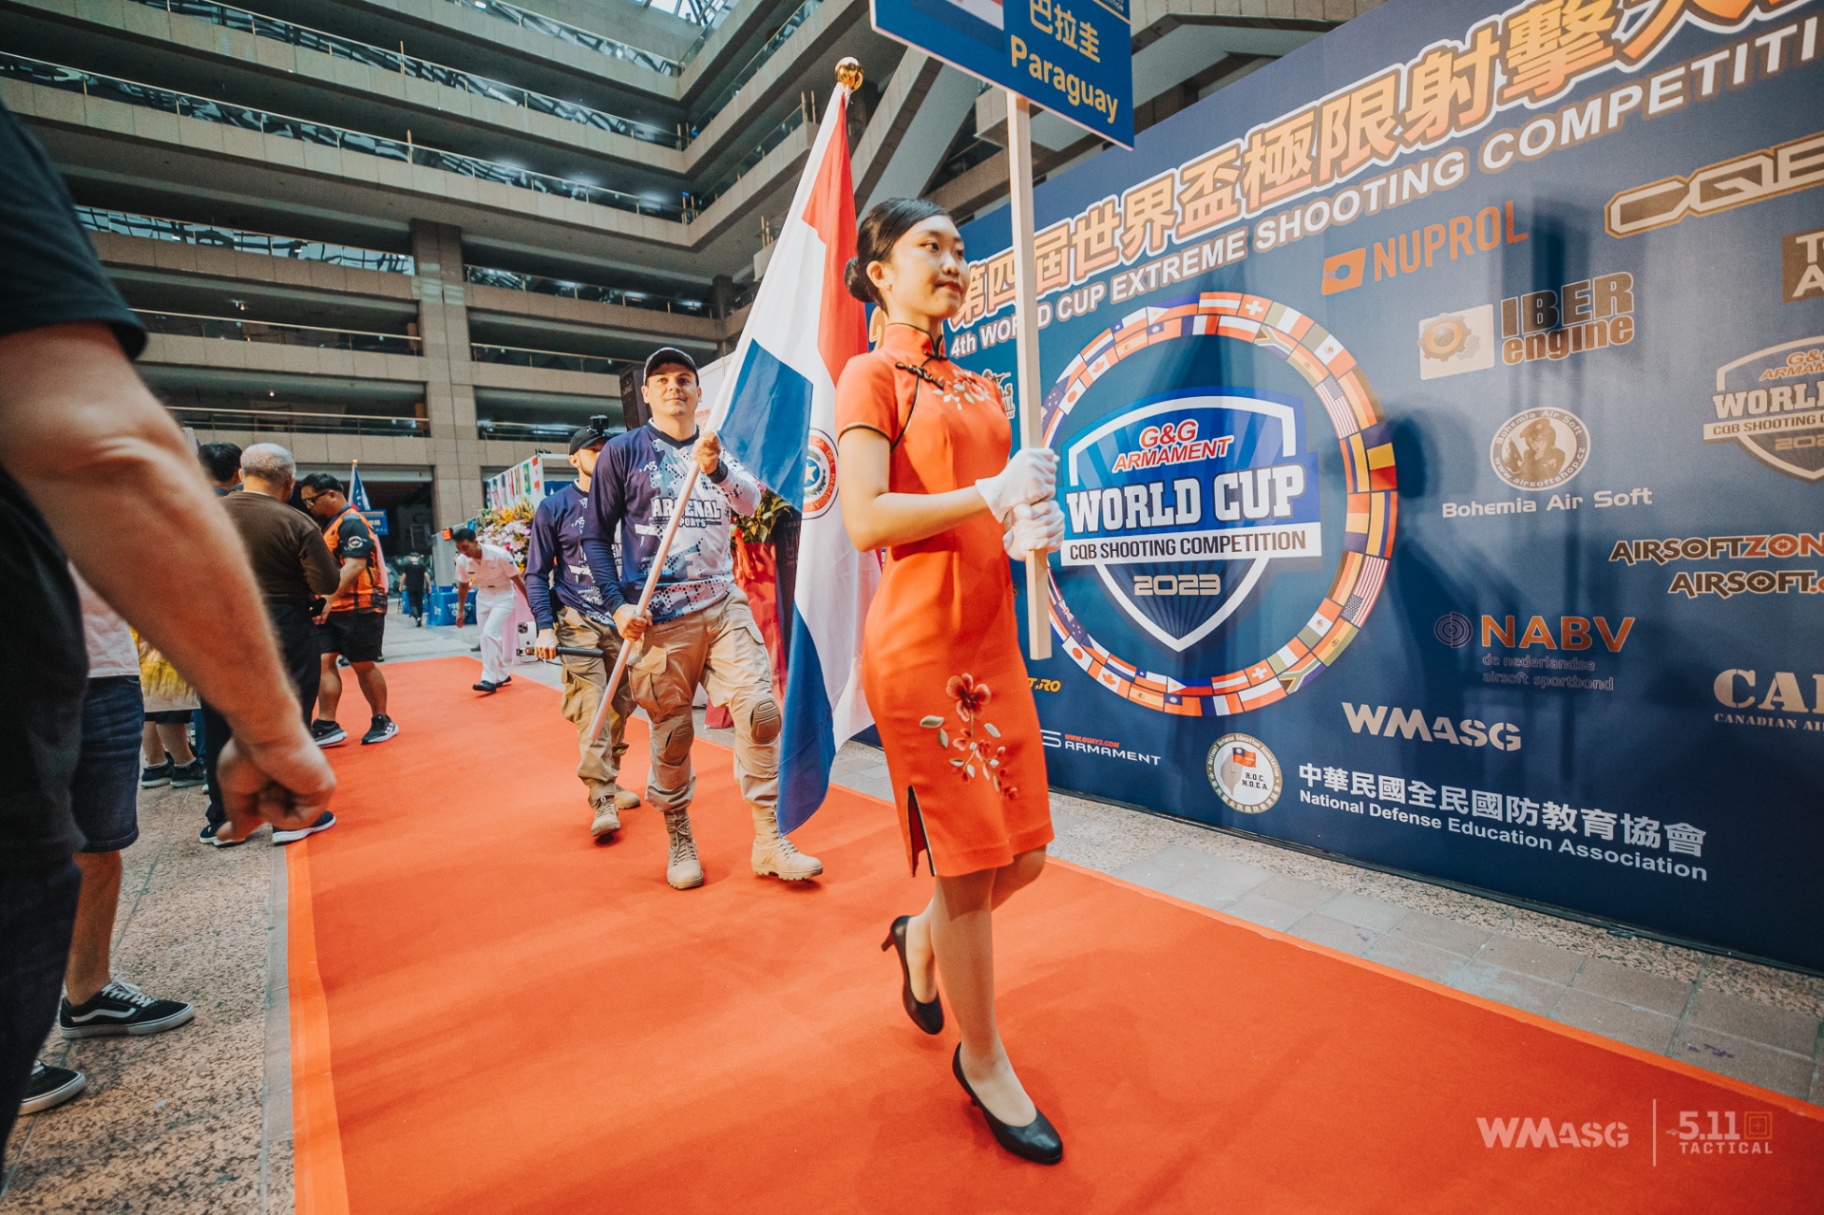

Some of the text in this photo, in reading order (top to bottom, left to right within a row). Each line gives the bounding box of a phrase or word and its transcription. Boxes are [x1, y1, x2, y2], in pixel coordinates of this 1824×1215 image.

[1030, 0, 1100, 63] 巴拉圭
[1010, 34, 1118, 124] Paraguay
[951, 334, 976, 357] 4th
[981, 304, 1052, 347] WOD
[1058, 284, 1105, 320] CUP
[1112, 230, 1246, 300] EXTREME
[1257, 152, 1465, 251] SHOOTING
[1374, 201, 1529, 282] NUPROL
[1501, 272, 1635, 339] IBER
[1502, 315, 1635, 365] engine
[1787, 349, 1824, 366] G&
[1139, 418, 1199, 449] G&G
[1496, 410, 1583, 444] Bohemia Air Soft
[1713, 423, 1741, 435] CQB
[1743, 413, 1816, 432] SHOOTING
[1112, 435, 1235, 473] ARMAMENT
[1494, 447, 1586, 487] www.airsoftshop.cz
[651, 498, 721, 519] ARENAL
[1066, 463, 1307, 534] WORLD CUP
[1442, 487, 1653, 518] Bohemia Air Soft
[678, 518, 707, 529] PORTS
[1070, 530, 1307, 560] CQB SHOOTING COMPETITION
[1133, 574, 1221, 596] 2023
[1481, 615, 1636, 653] NABV
[1482, 671, 1614, 691] airsoft sportbond
[1341, 702, 1522, 752] WMASG
[1714, 712, 1824, 731] CANADIAN AI
[1065, 740, 1161, 766] ARMAMENT
[1299, 762, 1707, 857] 中華民國全民國防教育協會
[1300, 789, 1364, 814] National
[1369, 802, 1442, 830] Defense
[1448, 817, 1552, 851] Education
[1558, 838, 1708, 881] Association
